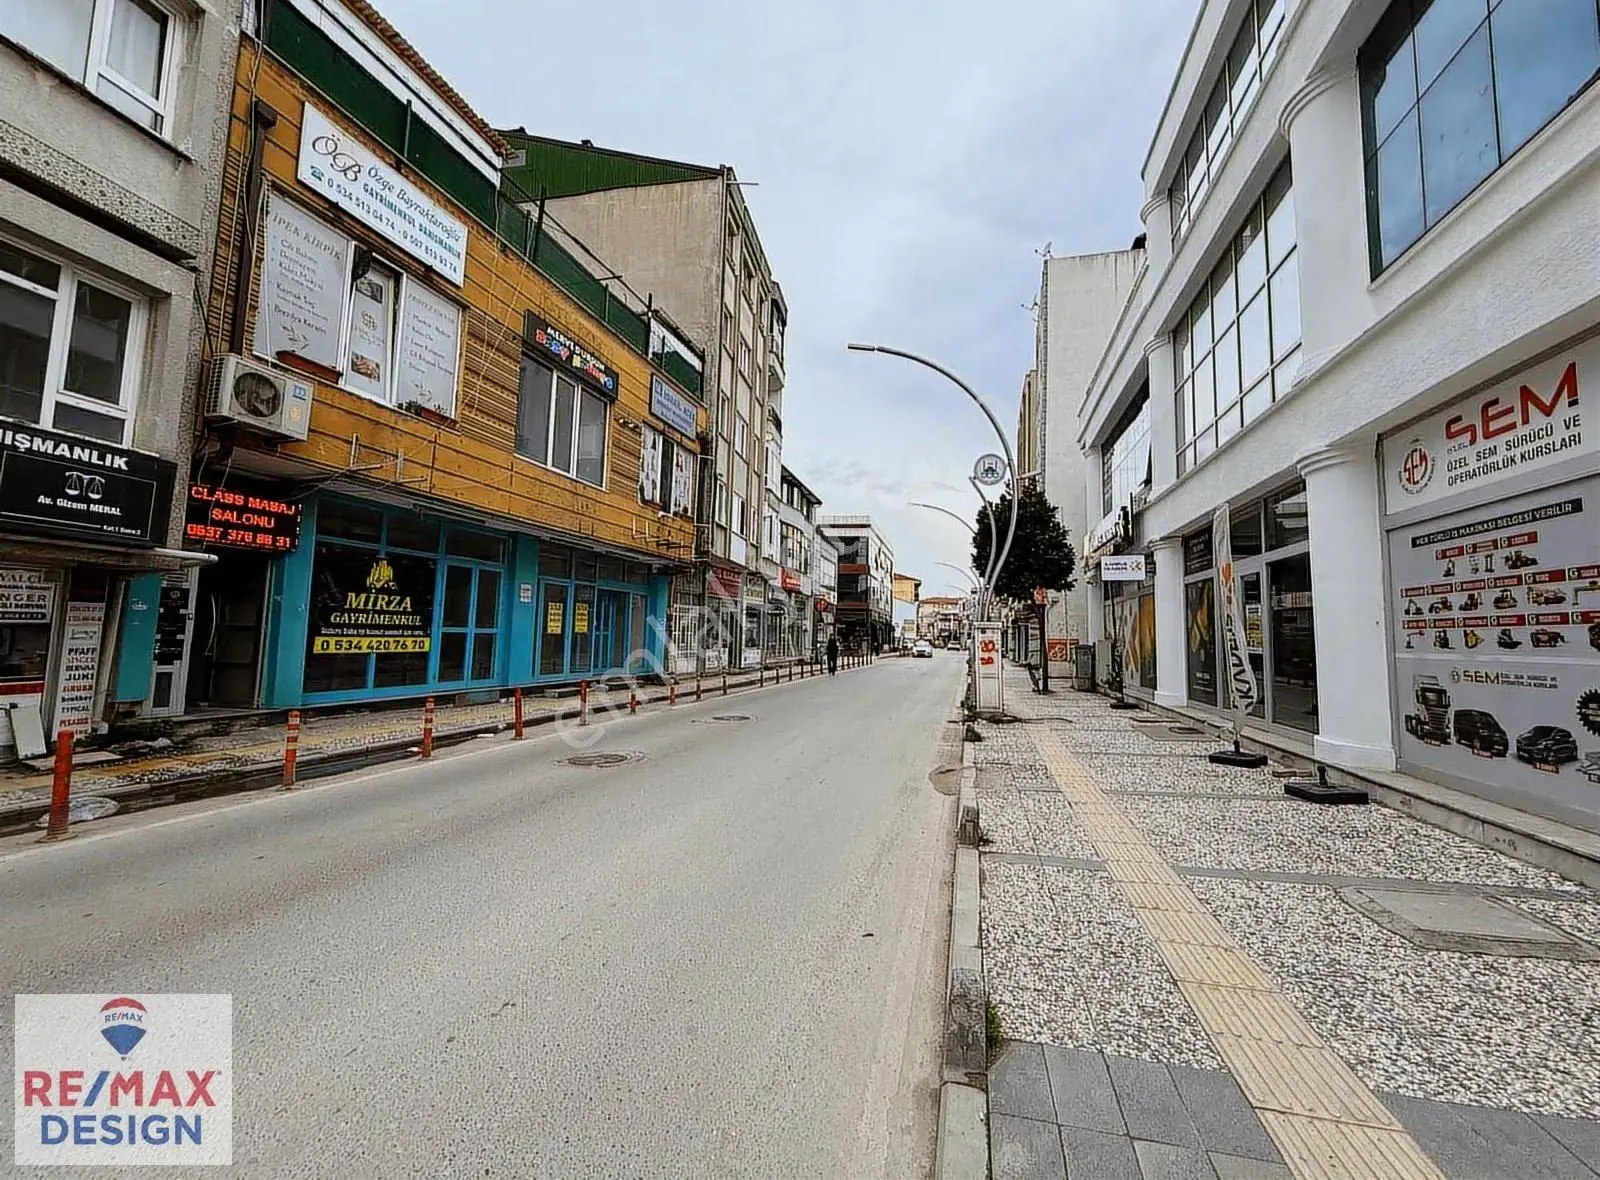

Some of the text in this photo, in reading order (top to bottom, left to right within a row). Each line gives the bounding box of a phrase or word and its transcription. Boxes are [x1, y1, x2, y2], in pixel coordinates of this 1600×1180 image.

[368, 165, 394, 192] Özge
[1444, 361, 1579, 446] SEM
[1475, 444, 1498, 462] SEM
[1505, 422, 1554, 451] SÜRÜCÜ
[1563, 414, 1581, 430] VE
[0, 429, 129, 471] IŞMANLIK
[1447, 454, 1517, 486] OPERATÖRLÜK
[1519, 432, 1582, 463] KURSLARI
[191, 486, 245, 506] CLASS
[89, 503, 122, 516] MERAL
[211, 508, 275, 528] SALONU
[1497, 512, 1533, 529] BELGESİ
[1535, 502, 1572, 519] VERİLİR
[344, 588, 412, 611] MİRZA
[330, 611, 422, 625] GAYRİMENKUL
[321, 639, 425, 651] 0 534 420 76 70
[1462, 669, 1500, 685] SEM
